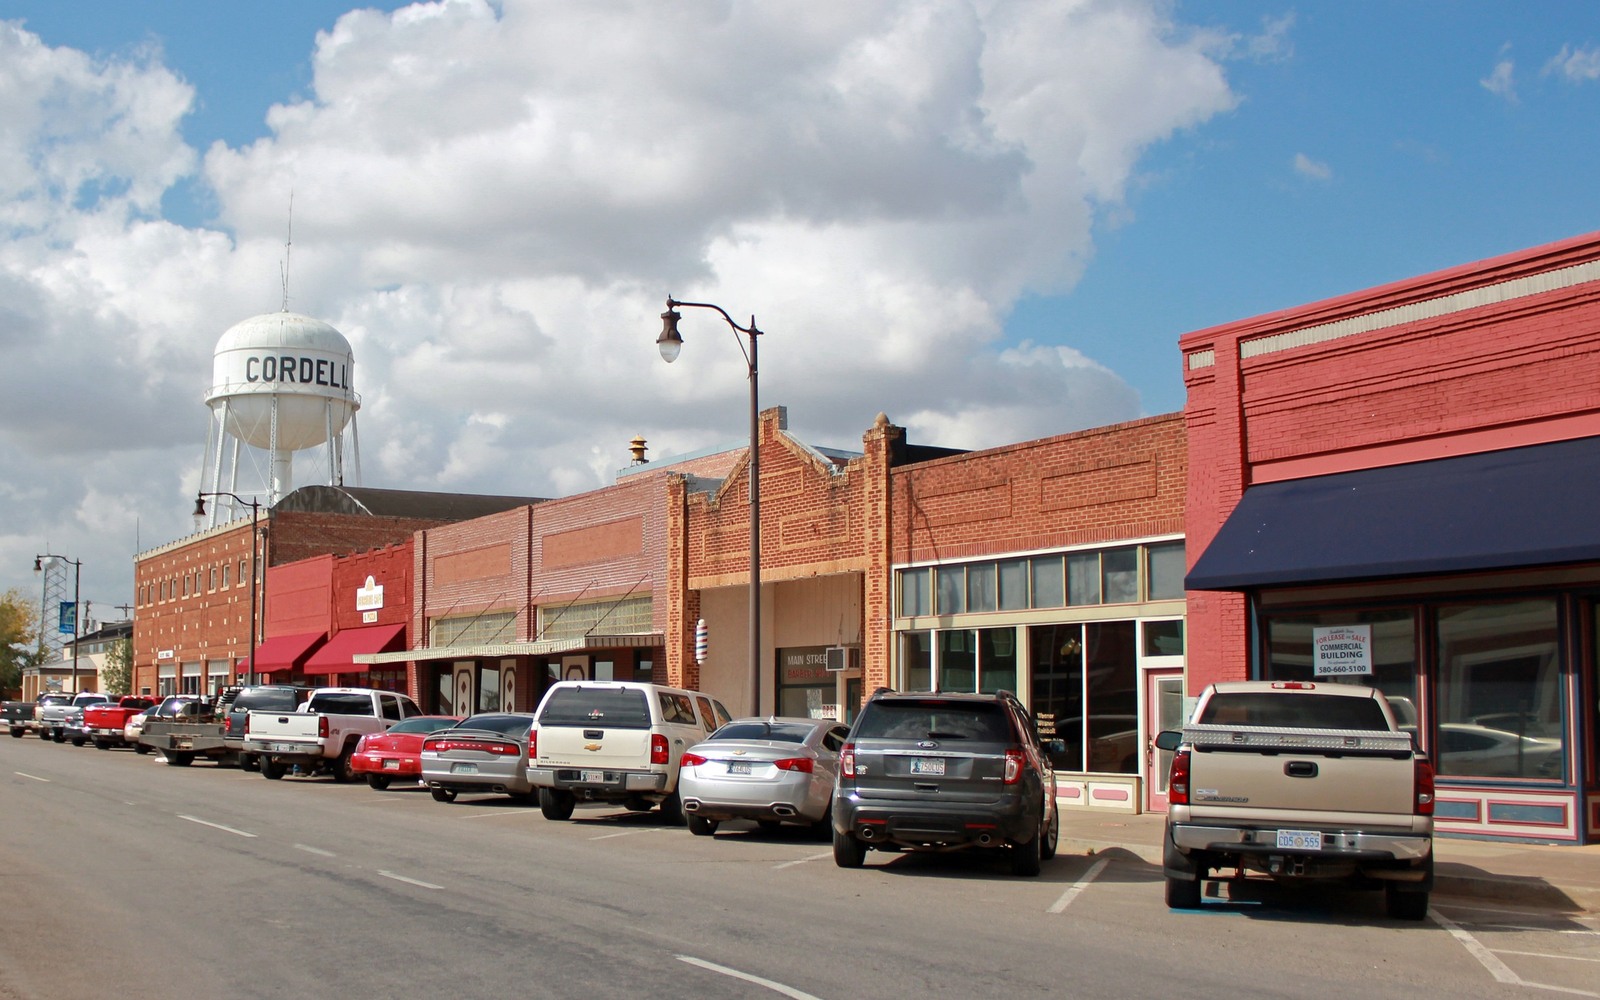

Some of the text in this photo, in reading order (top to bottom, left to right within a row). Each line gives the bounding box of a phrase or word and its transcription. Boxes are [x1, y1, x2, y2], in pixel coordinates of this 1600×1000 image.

[246, 356, 348, 390] CORDELL
[1328, 634, 1345, 642] LEASE
[1352, 634, 1366, 643] SALE
[1320, 643, 1363, 651] COMMERCIAL
[788, 654, 827, 665] MAIN STREE
[1321, 651, 1363, 660] BUILDING
[1305, 837, 1320, 848] 555
